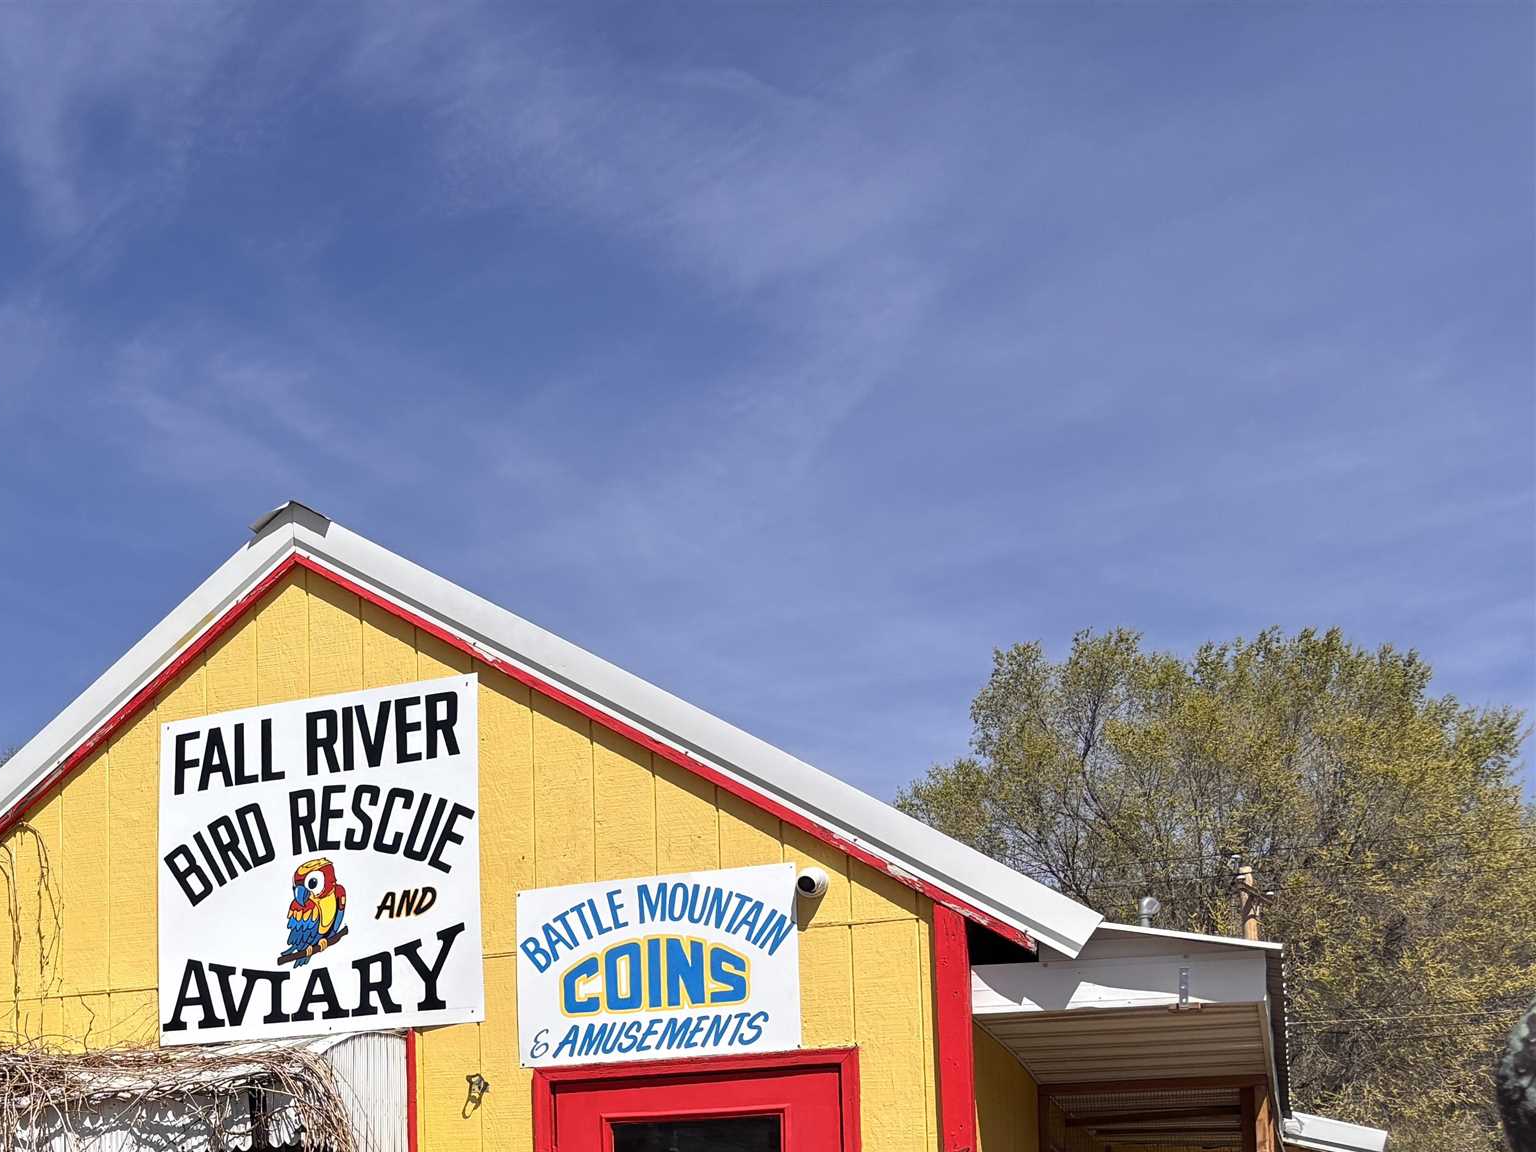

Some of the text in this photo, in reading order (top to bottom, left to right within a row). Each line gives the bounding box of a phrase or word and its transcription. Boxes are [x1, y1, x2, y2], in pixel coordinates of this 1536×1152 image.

[174, 691, 460, 795] FALL RIVER
[164, 784, 475, 907] BIRD RESCUE
[375, 886, 437, 920] AND
[520, 882, 796, 974] BATTLE MOUNTAIN
[163, 922, 465, 1032] AVIARY
[560, 934, 751, 1017] COINS
[530, 1011, 769, 1059] & AMUSEMENTS
